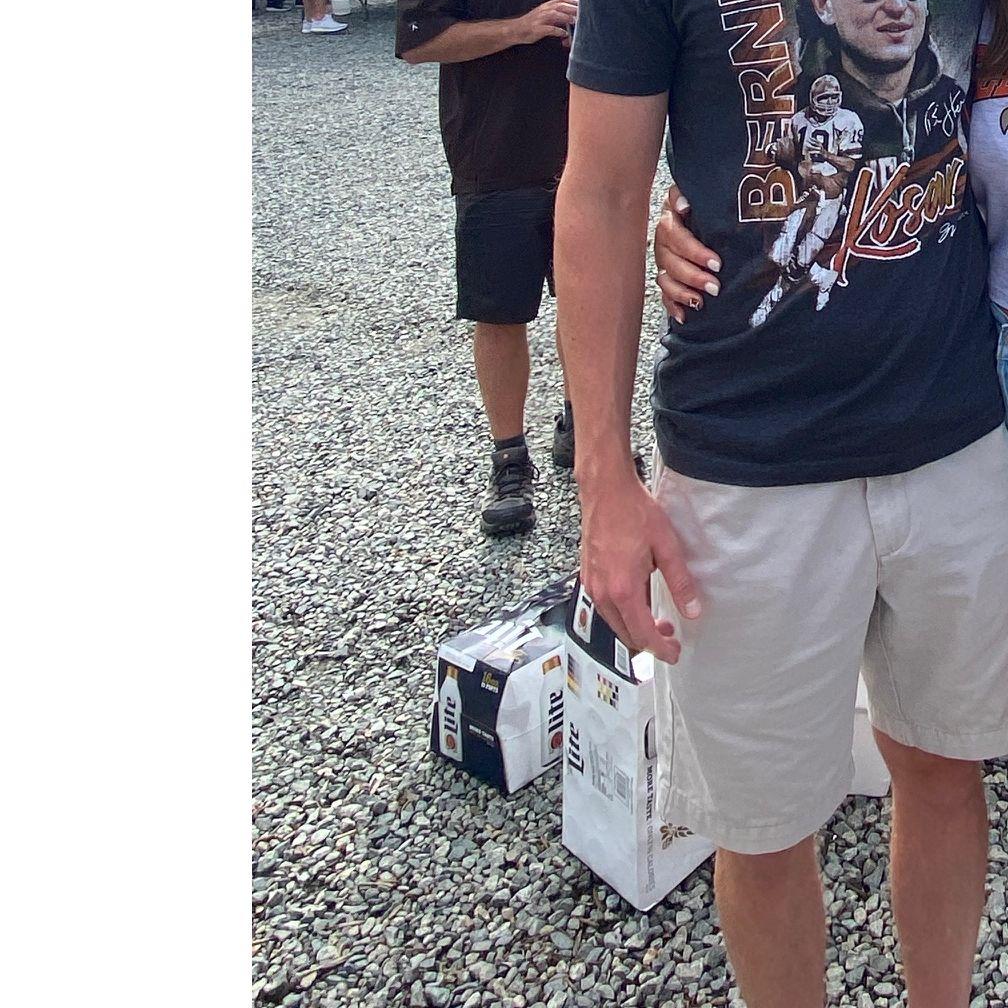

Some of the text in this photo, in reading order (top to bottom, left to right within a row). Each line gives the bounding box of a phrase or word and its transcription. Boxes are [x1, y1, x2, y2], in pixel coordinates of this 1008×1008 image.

[831, 157, 964, 287] Kosar
[443, 696, 458, 735] Lite
[567, 721, 585, 777] Lite
[646, 765, 654, 793] MORE
[646, 793, 654, 821] TASTE
